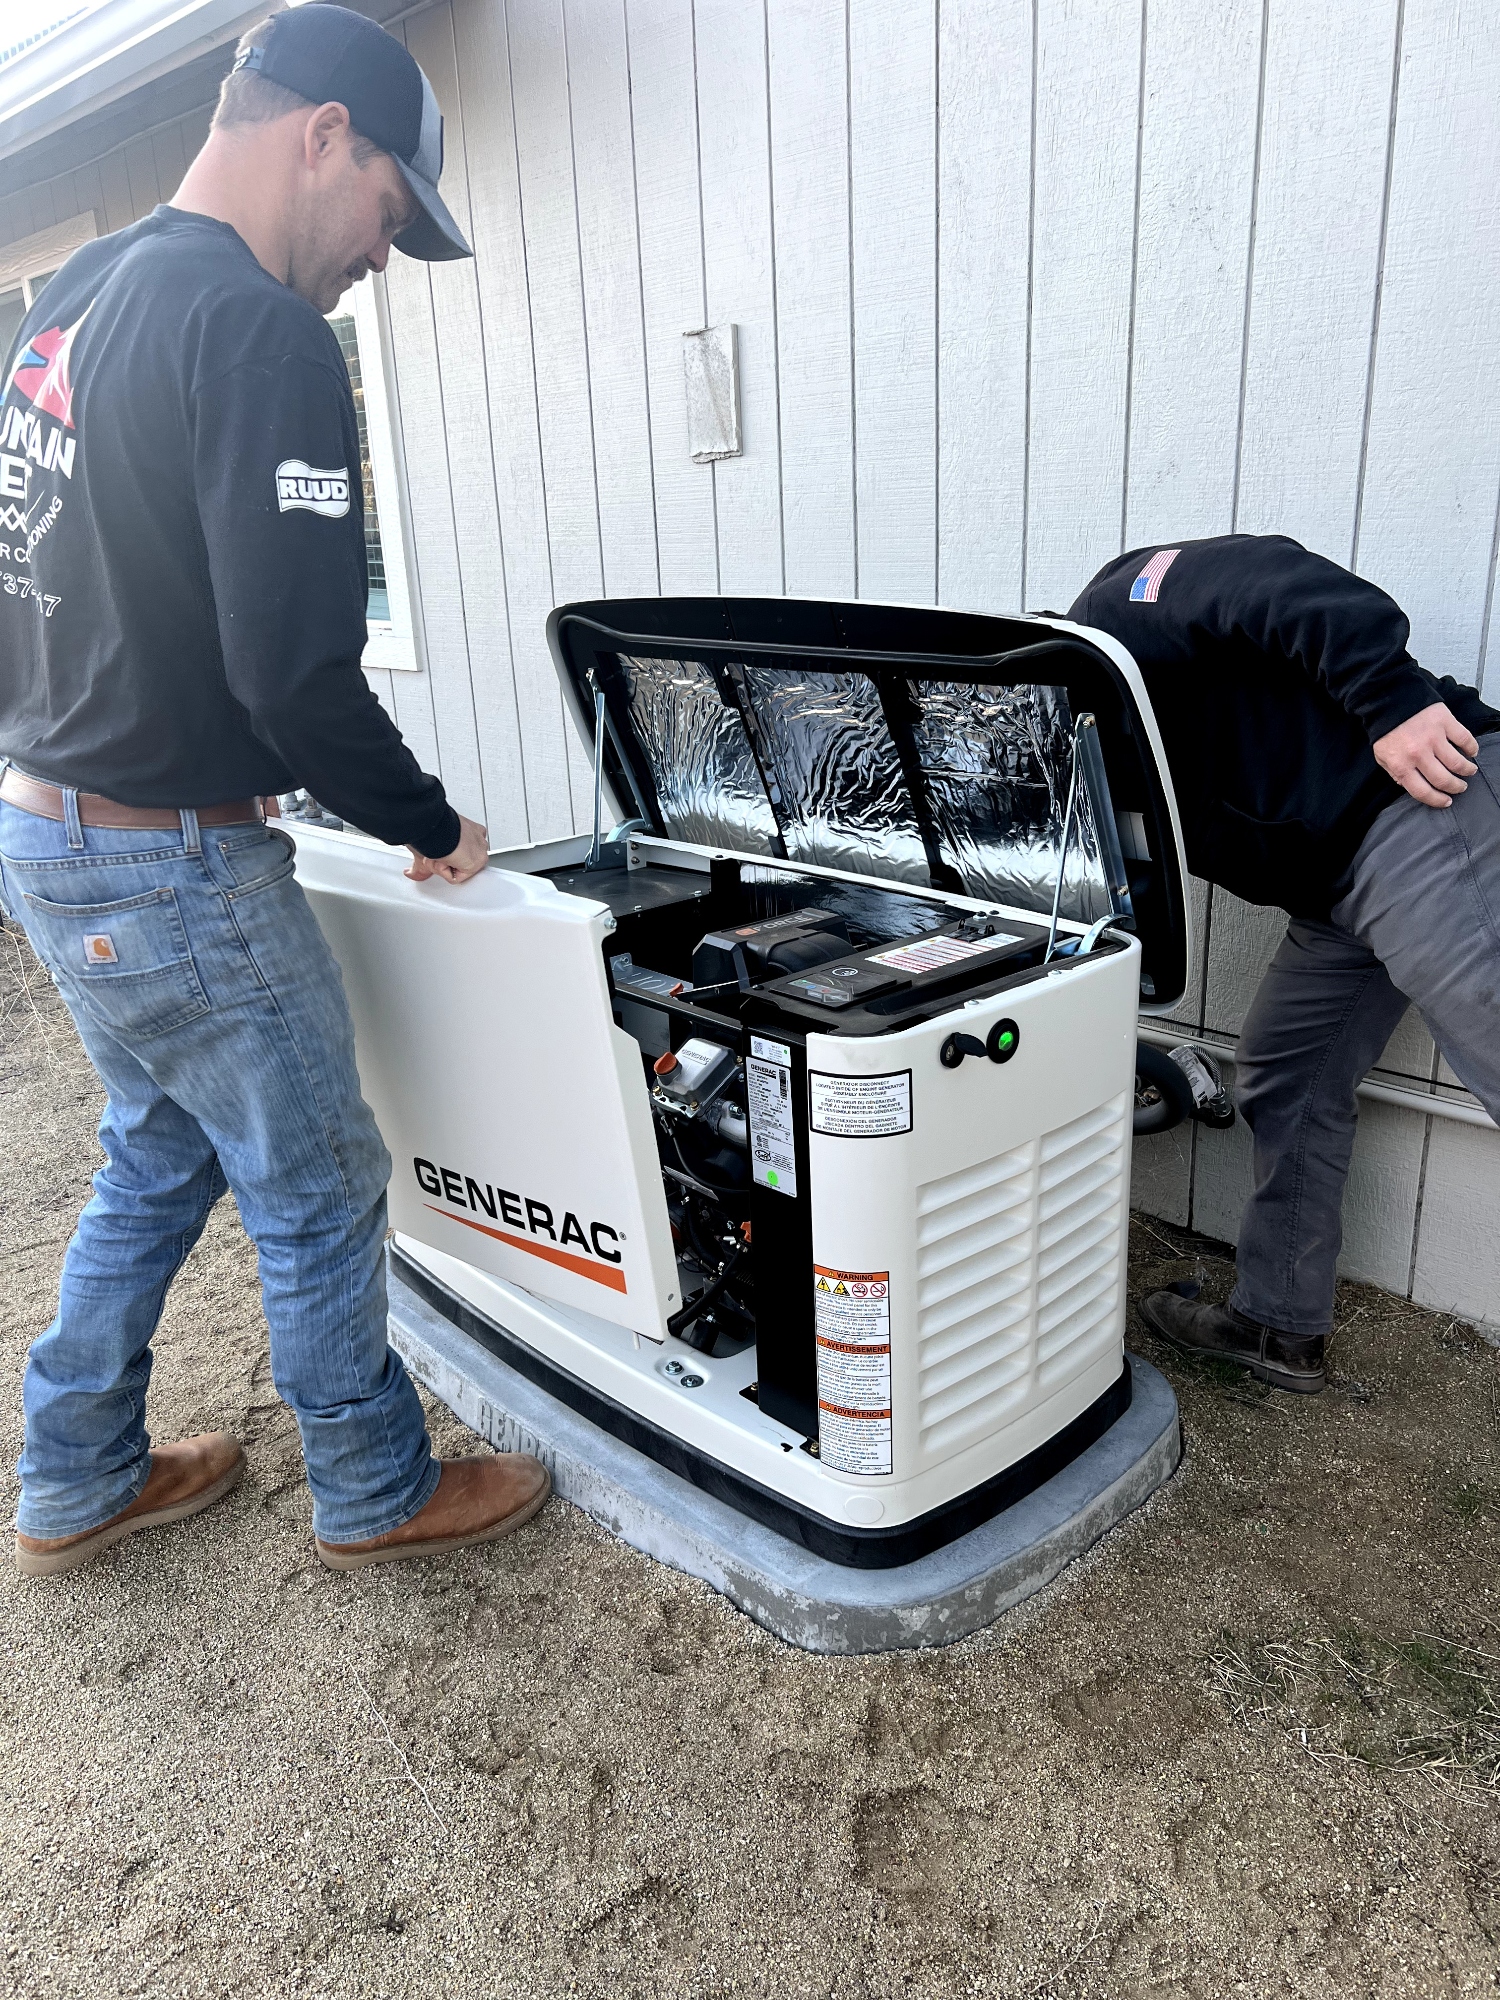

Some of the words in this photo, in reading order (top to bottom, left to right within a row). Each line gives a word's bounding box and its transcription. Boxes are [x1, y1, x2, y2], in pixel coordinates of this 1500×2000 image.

[279, 478, 348, 500] RUUD
[750, 1063, 777, 1076] GENERAC
[413, 1157, 622, 1264] GENERAC
[836, 1272, 874, 1281] WARNING
[827, 1341, 887, 1353] AVERTISSEMENT
[833, 1406, 885, 1418] ADVERTENCIA
